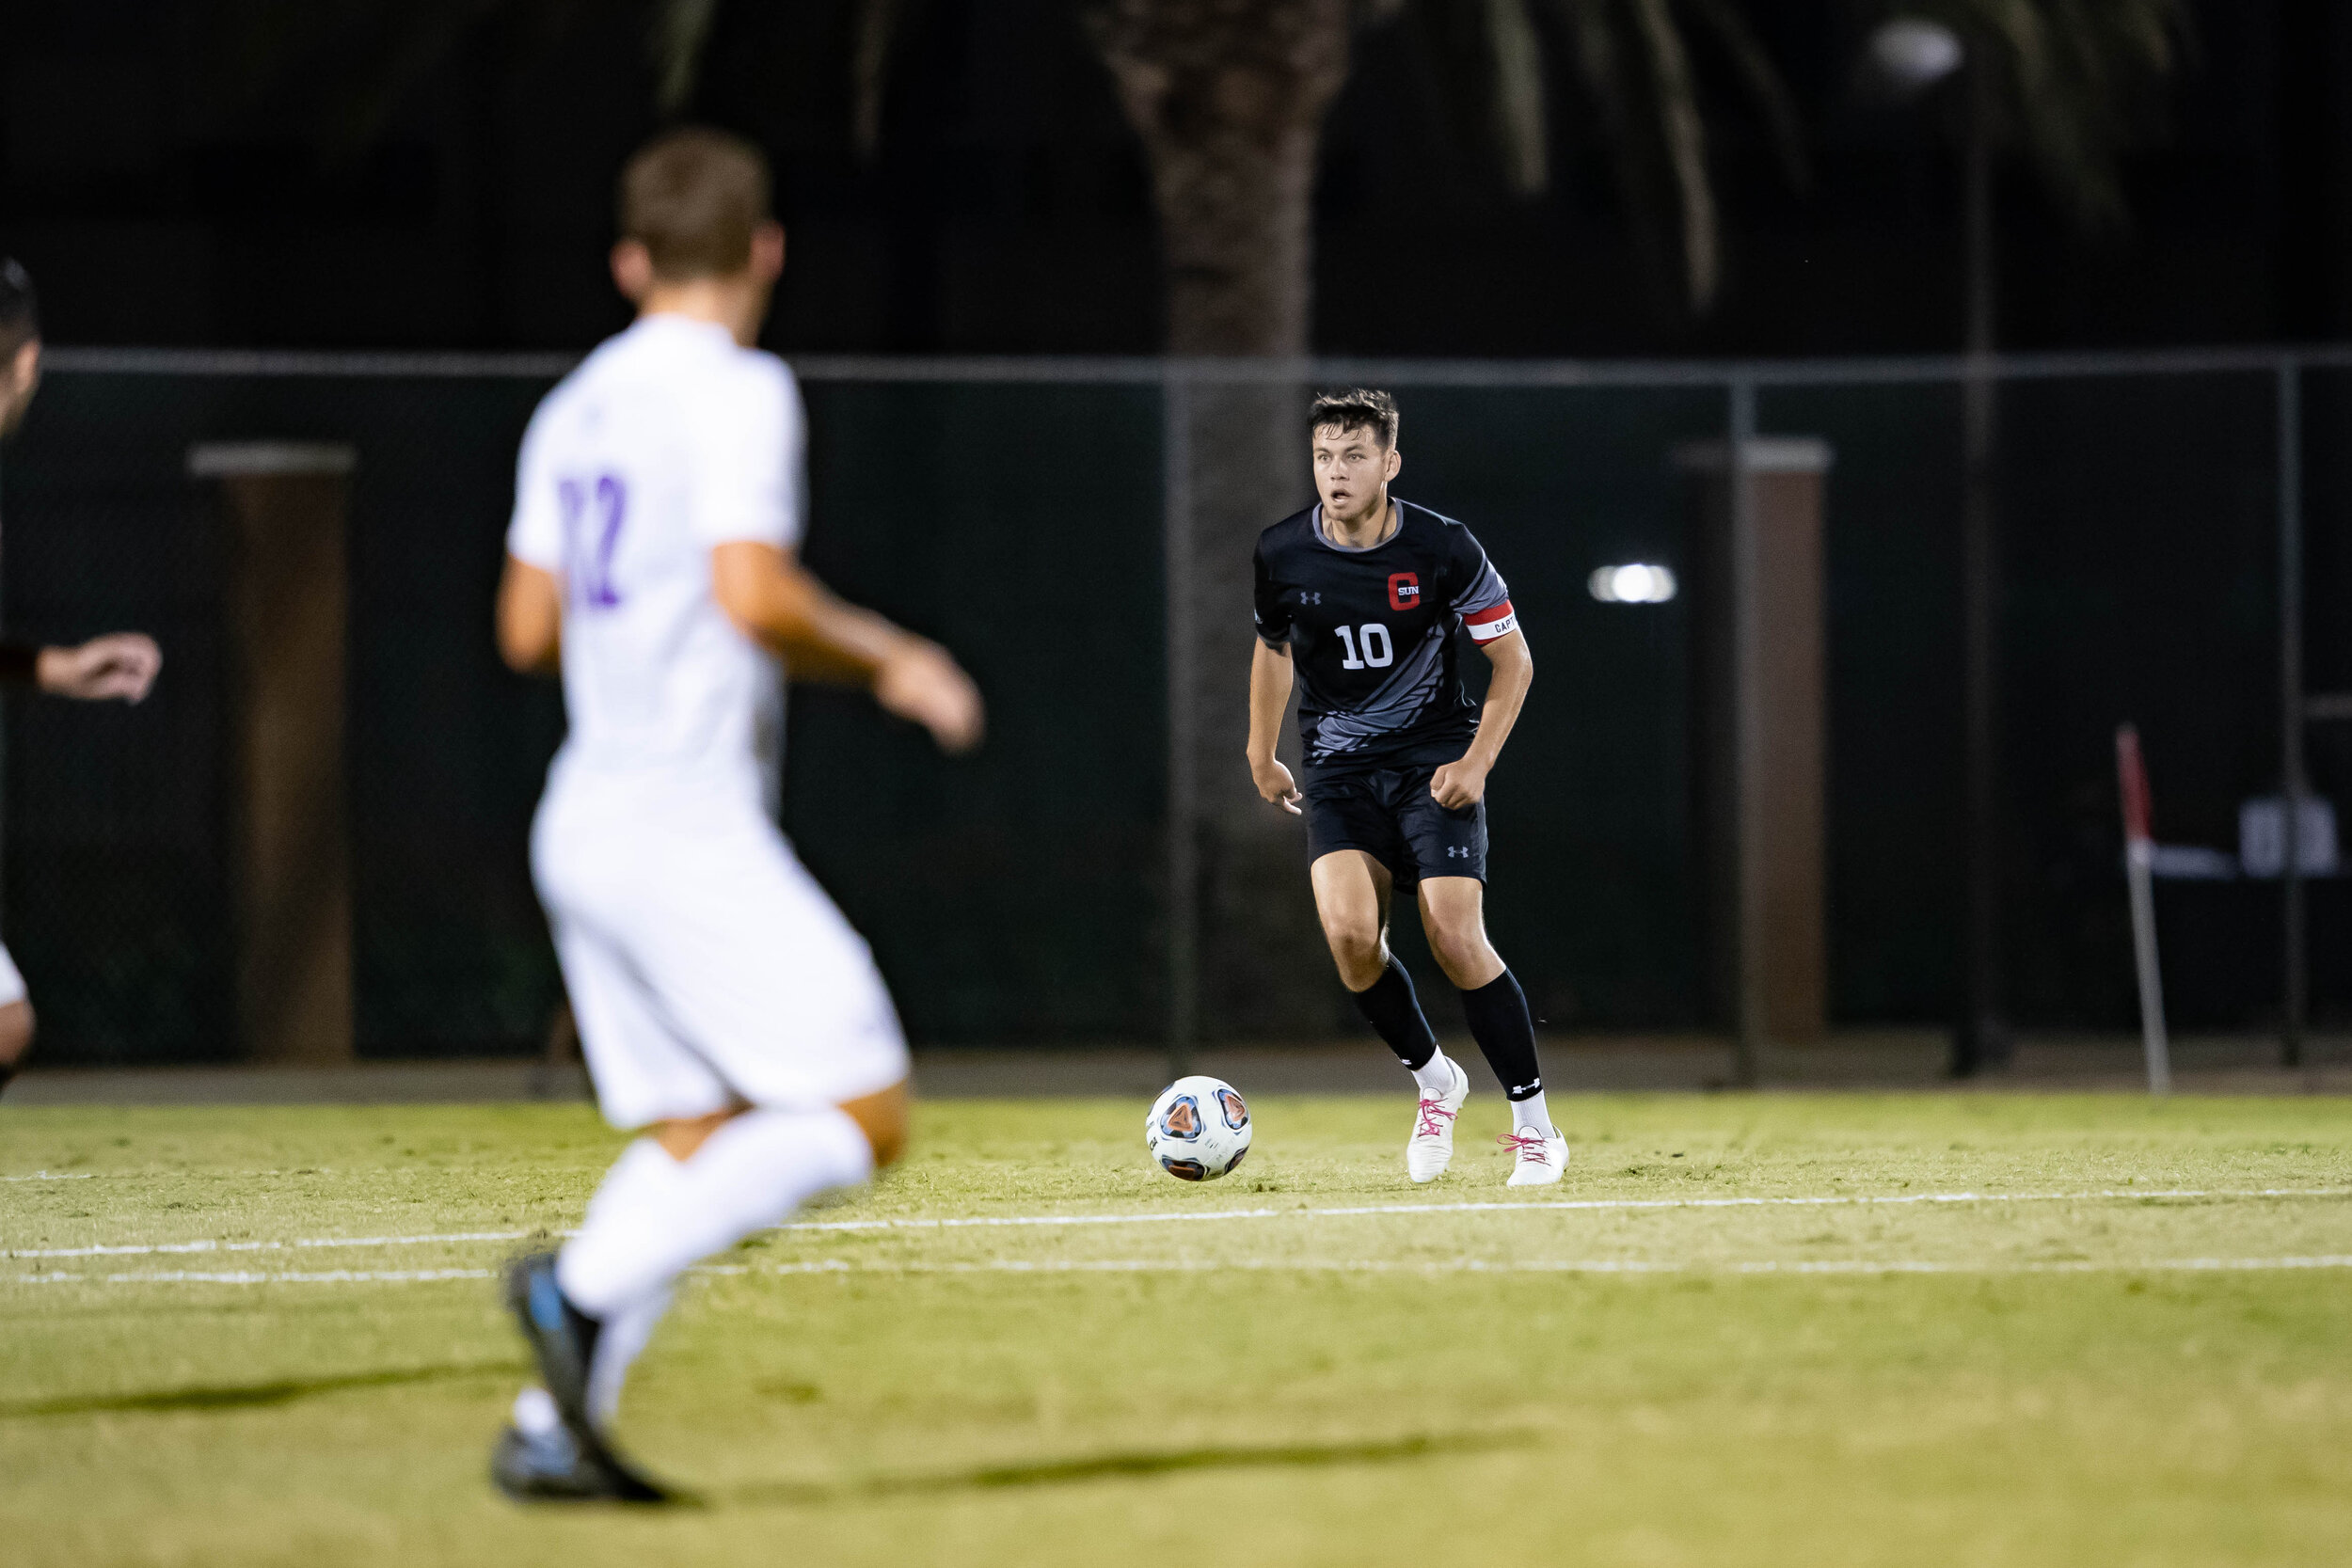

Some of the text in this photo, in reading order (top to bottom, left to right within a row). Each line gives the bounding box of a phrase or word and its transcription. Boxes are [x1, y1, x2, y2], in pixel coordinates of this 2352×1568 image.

[557, 476, 628, 607] 12
[1388, 572, 1420, 611] C
[1397, 585, 1420, 596] SUN
[1334, 623, 1393, 670] 10
